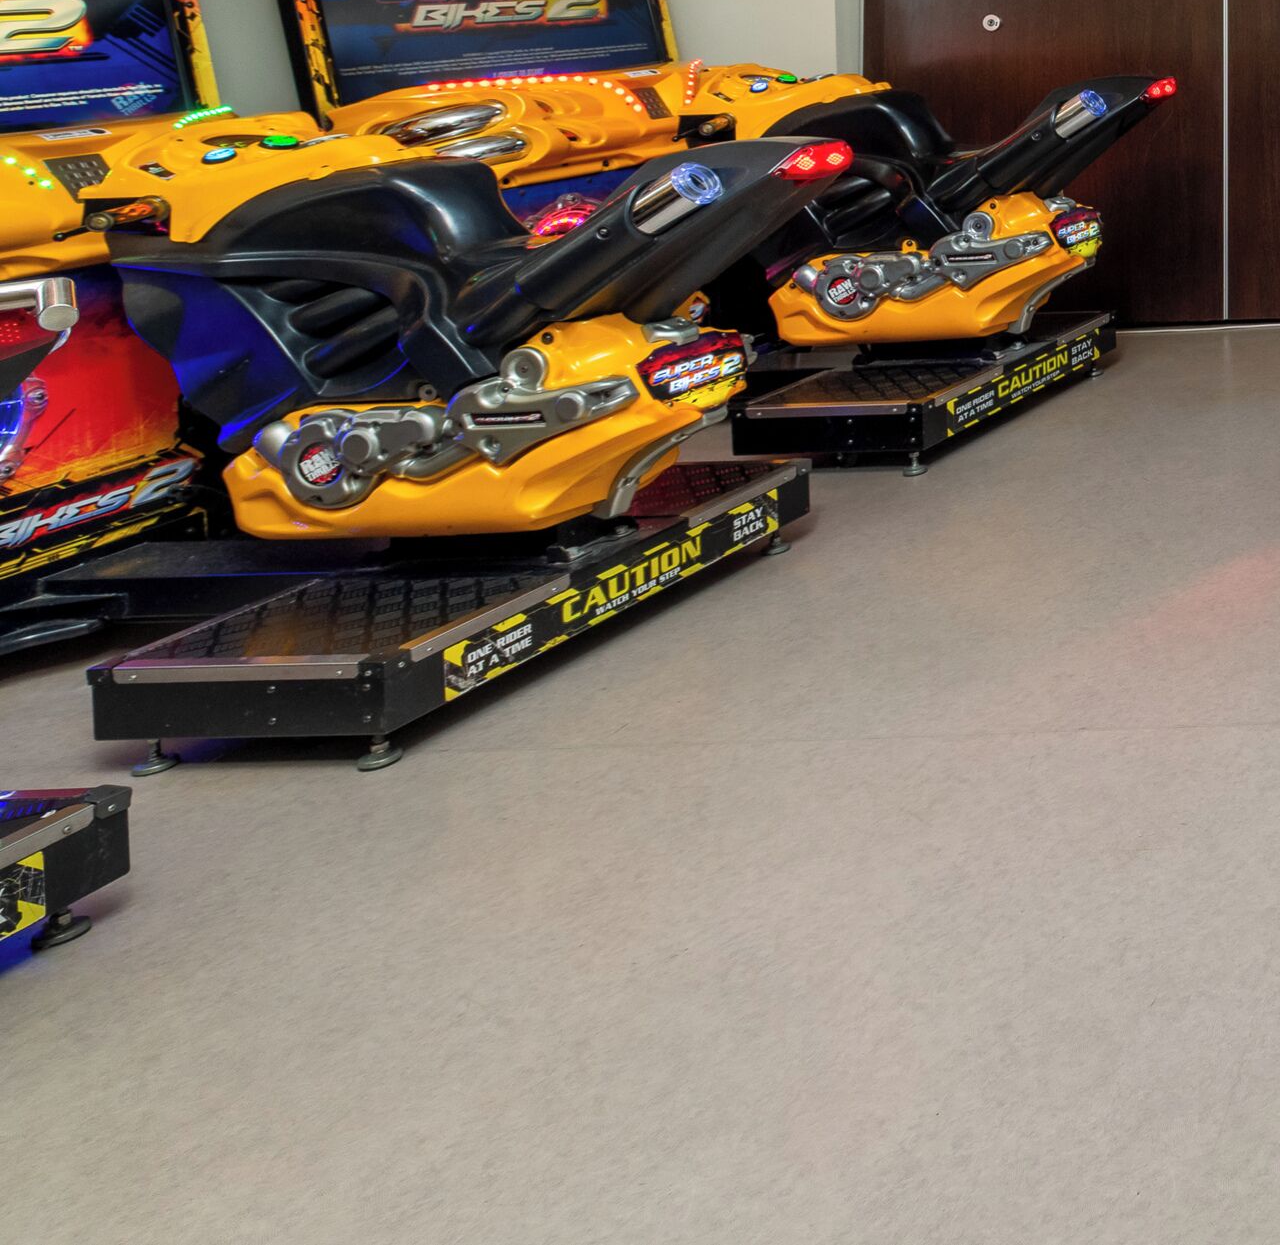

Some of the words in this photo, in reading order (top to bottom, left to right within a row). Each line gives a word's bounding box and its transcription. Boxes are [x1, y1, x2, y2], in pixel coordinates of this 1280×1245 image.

[411, 0, 547, 31] BIKES
[1057, 220, 1085, 239] SUPER
[1066, 229, 1089, 245] BIKES
[827, 279, 854, 298] RAW
[1071, 338, 1093, 356] STAY
[1071, 348, 1094, 365] BACK
[653, 354, 715, 384] SUPER
[669, 365, 721, 394] BIKES
[721, 353, 743, 377] 2
[997, 350, 1069, 399] CAUTION
[1011, 386, 1031, 400] WATCH
[1029, 378, 1046, 393] YOUR
[1044, 369, 1061, 385] STEP
[955, 400, 972, 415] ONE
[972, 389, 995, 408] RIDER
[957, 412, 970, 423] AT
[975, 399, 995, 416] TIME
[299, 446, 336, 476] RAW
[129, 457, 197, 509] 2
[732, 517, 765, 542] BACK
[733, 506, 764, 530] STAY
[561, 534, 702, 624] CAUTION
[595, 592, 629, 617] WATCH
[631, 579, 658, 601] YOUR
[659, 567, 681, 586] STEP
[466, 641, 494, 664] ONE
[496, 623, 533, 651] RIDER
[466, 659, 485, 678] AT
[504, 635, 533, 660] TIME
